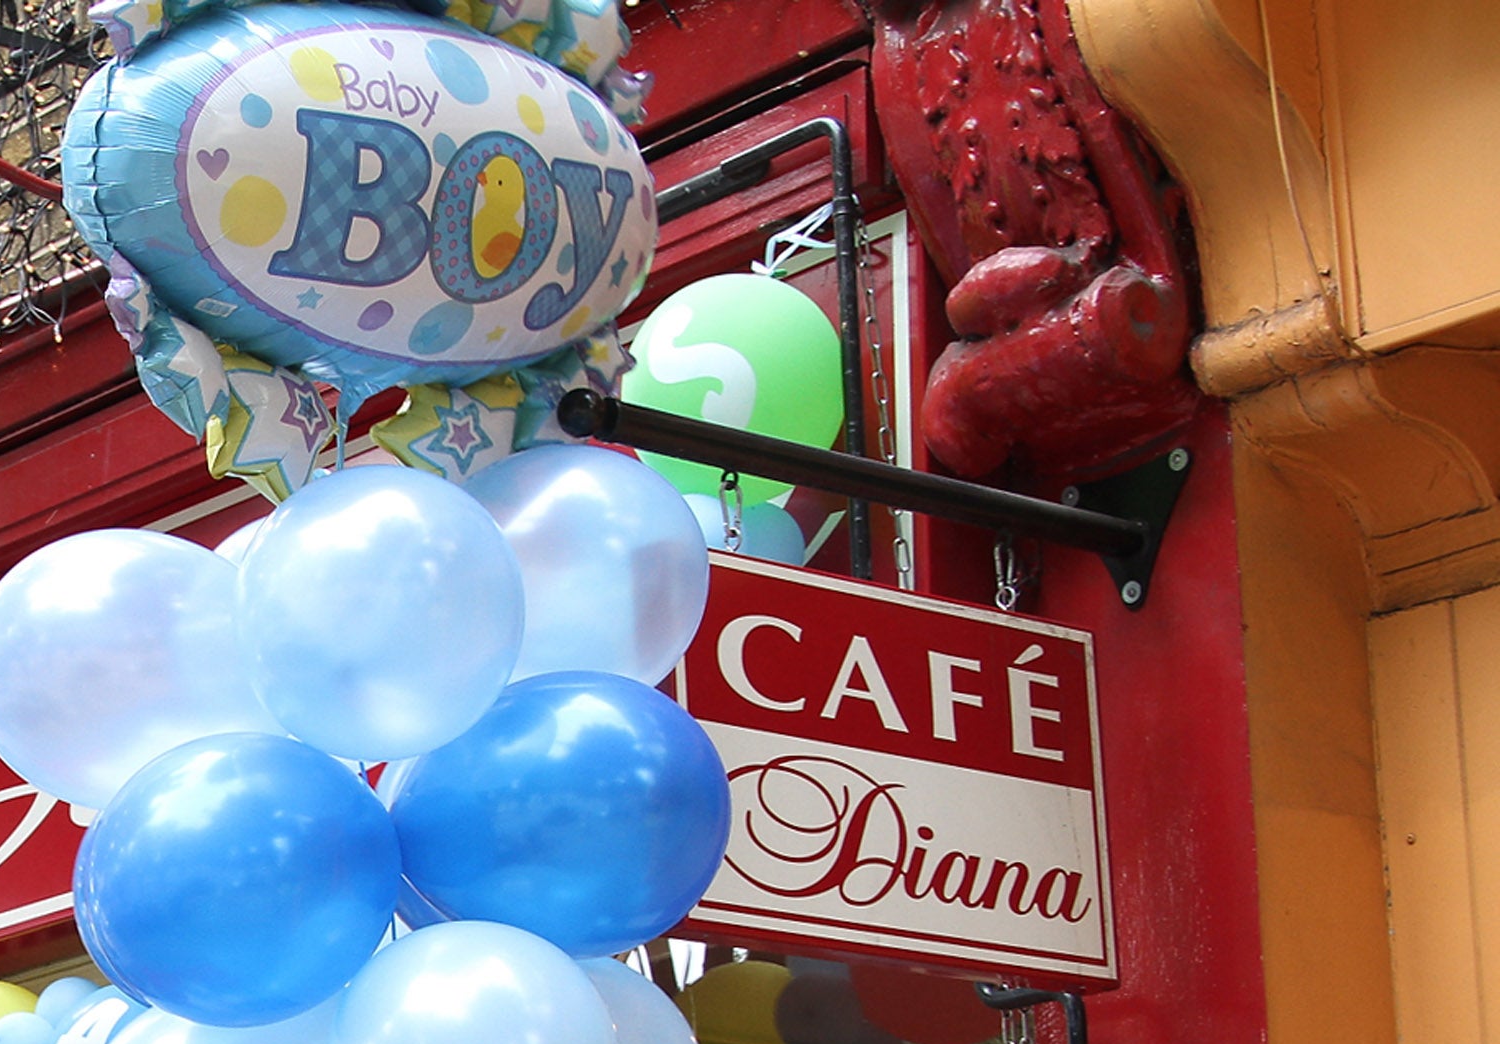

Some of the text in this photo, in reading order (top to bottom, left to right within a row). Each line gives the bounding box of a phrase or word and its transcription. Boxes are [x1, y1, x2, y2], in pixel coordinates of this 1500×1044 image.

[331, 61, 441, 128] Baby
[268, 106, 634, 332] BOY
[717, 614, 1064, 762] CAFÉ
[724, 755, 1092, 924] Diana
